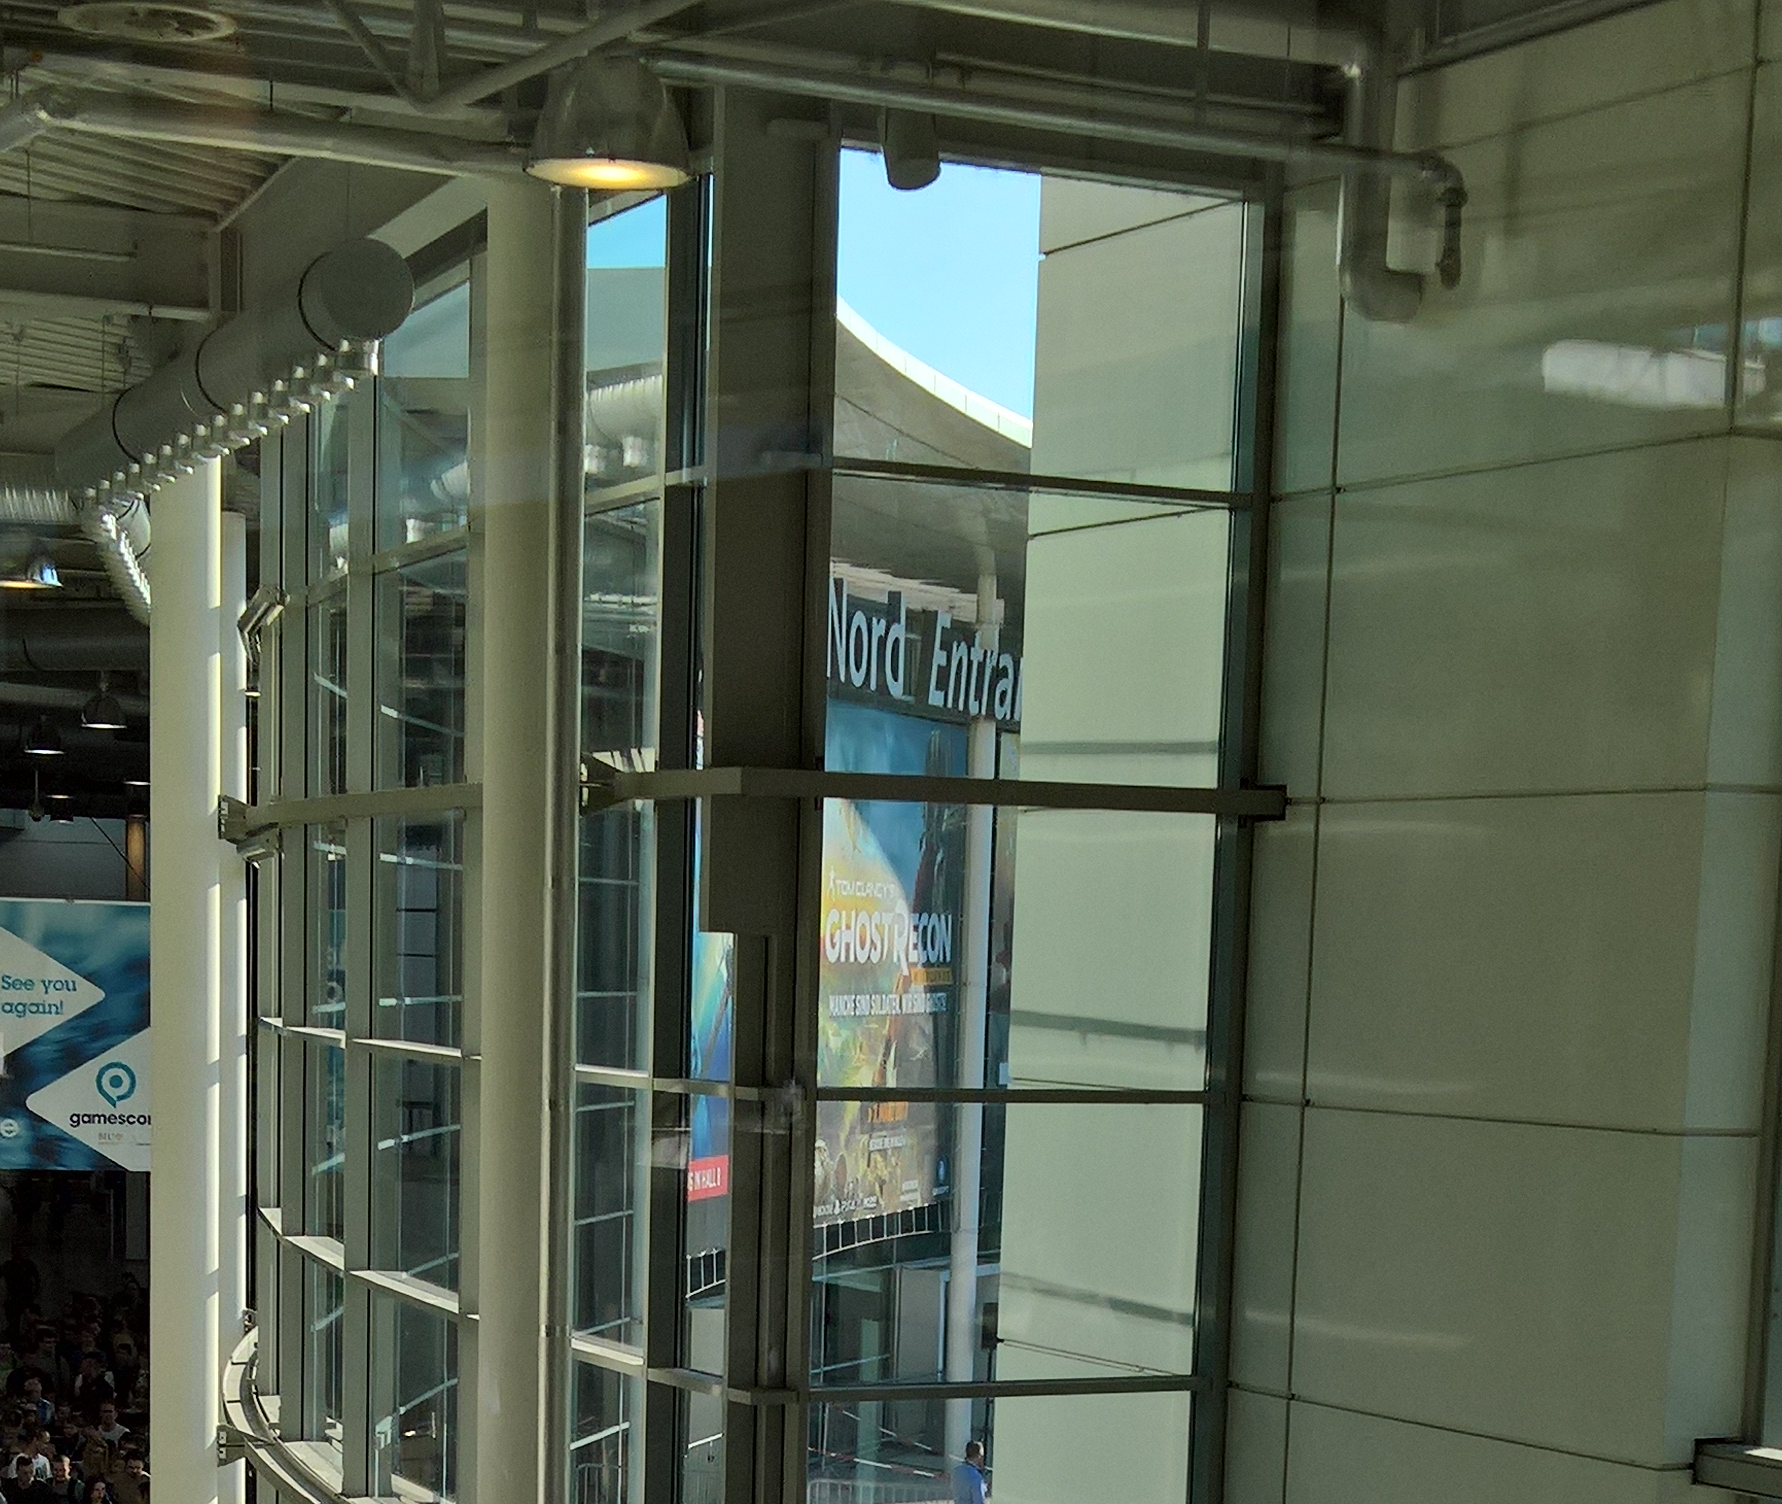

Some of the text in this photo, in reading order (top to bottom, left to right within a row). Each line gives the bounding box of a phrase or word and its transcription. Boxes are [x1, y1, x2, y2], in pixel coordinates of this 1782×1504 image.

[827, 574, 907, 700] Nord
[1, 975, 77, 994] See you
[1, 1000, 64, 1018] again!
